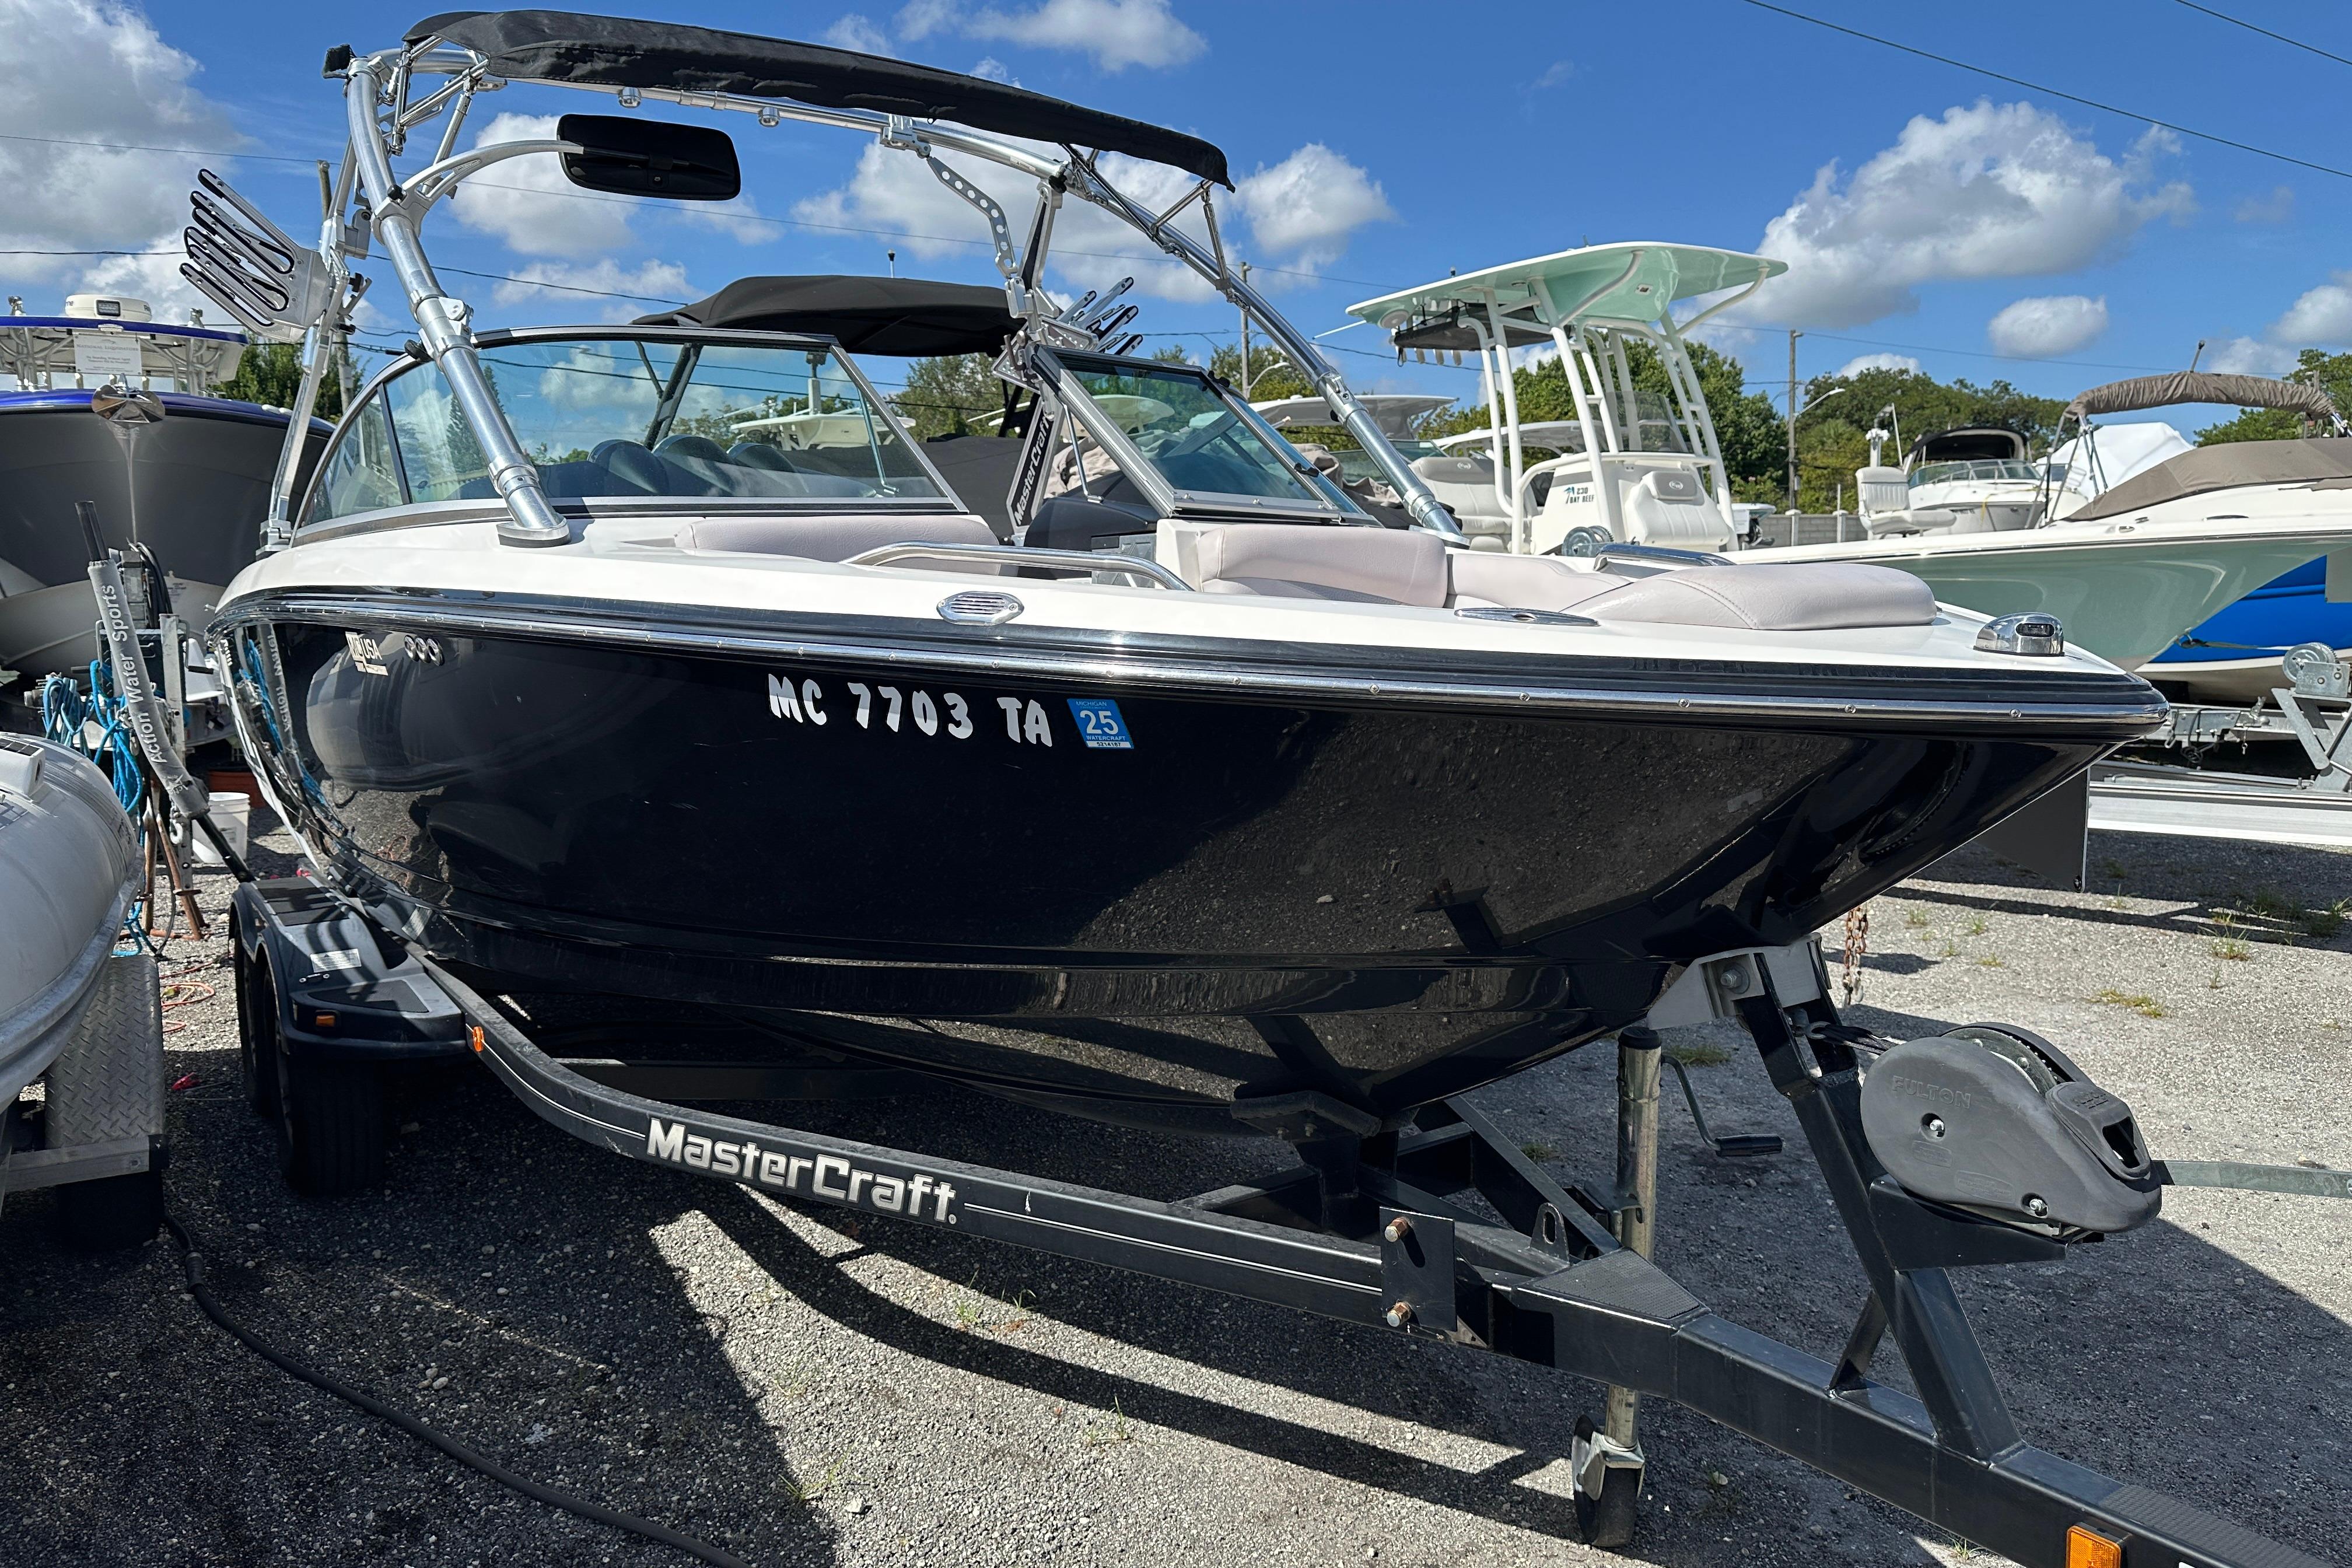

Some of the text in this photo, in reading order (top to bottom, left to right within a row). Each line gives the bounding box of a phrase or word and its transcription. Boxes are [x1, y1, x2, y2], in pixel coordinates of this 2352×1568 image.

[1014, 415, 1049, 525] MasterCraft
[102, 584, 167, 764] Action Water Sports
[768, 673, 1052, 747] MC 7703 TA
[1080, 710, 1119, 735] 25
[1892, 1075, 1972, 1109] FULTON
[646, 1117, 957, 1223] MasterCraft
